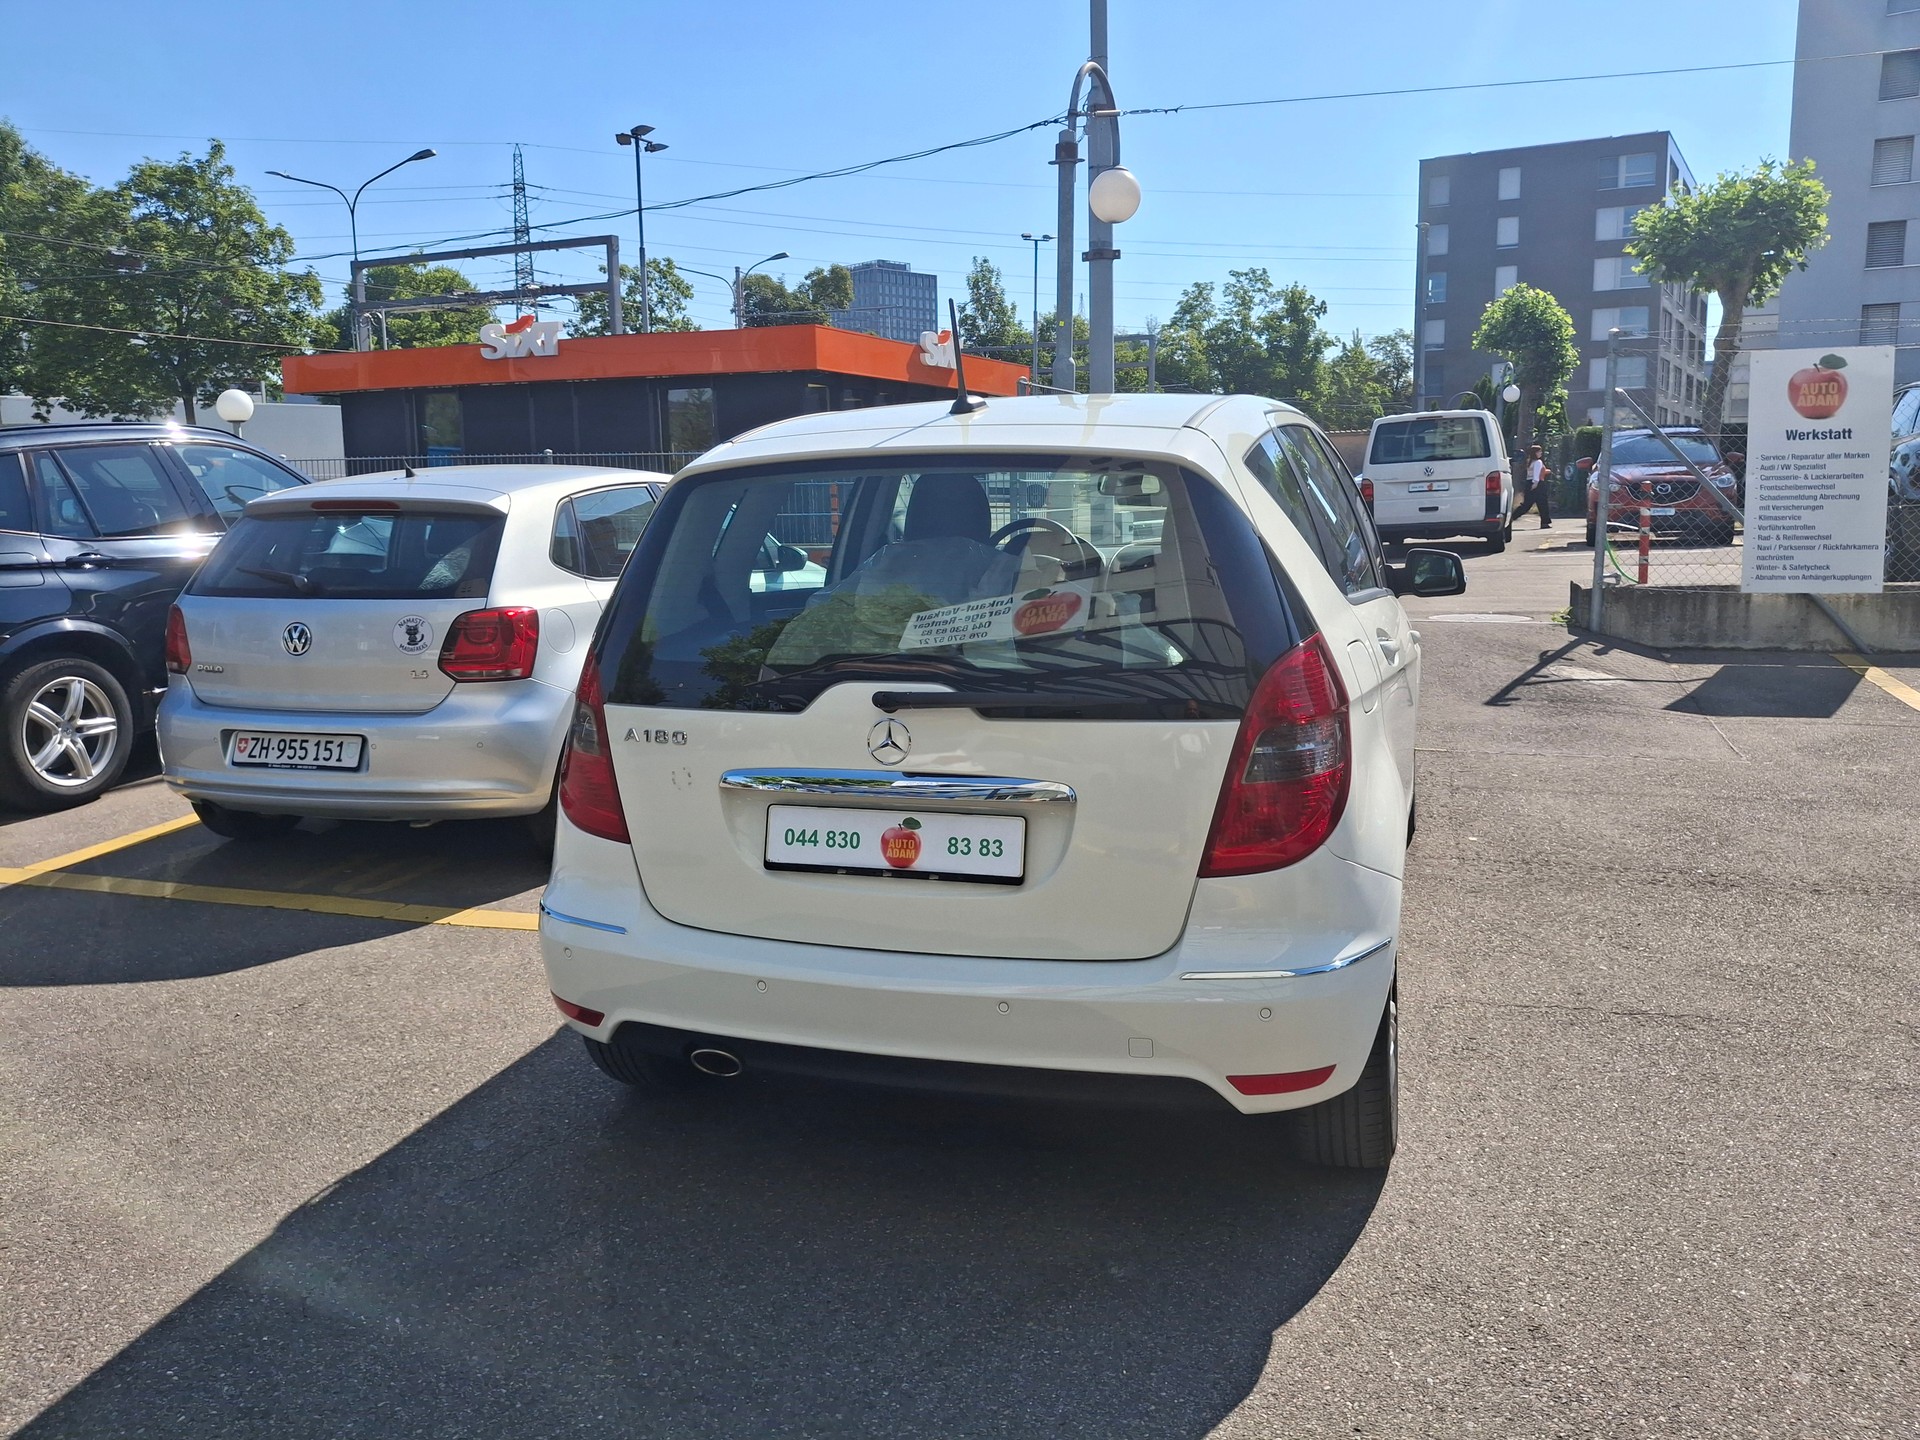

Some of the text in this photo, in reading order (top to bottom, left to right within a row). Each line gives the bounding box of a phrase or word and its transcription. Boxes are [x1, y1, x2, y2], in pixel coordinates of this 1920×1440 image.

[1800, 382, 1838, 395] AUTO
[1797, 394, 1840, 407] ADAM
[1785, 428, 1853, 441] Werkstatt
[1760, 453, 1786, 461] Service
[1791, 453, 1825, 462] Reparatur
[1793, 463, 1827, 471] Spezialist
[1759, 483, 1836, 491] Frontscheibenwechsel
[1819, 493, 1860, 501] Abrechnung
[1771, 504, 1824, 512] Versicherungen
[1822, 543, 1879, 551] Rückfahrkamera
[1789, 564, 1831, 572] Safetycheck
[1801, 573, 1872, 582] Anhängerkupplungen
[398, 617, 426, 629] NAMASTE
[197, 664, 224, 673] POLO
[624, 728, 688, 745] A180
[784, 828, 861, 849] 044 830
[888, 838, 915, 849] AUTO
[947, 836, 1004, 858] 83 83
[886, 848, 915, 859] ADAM
